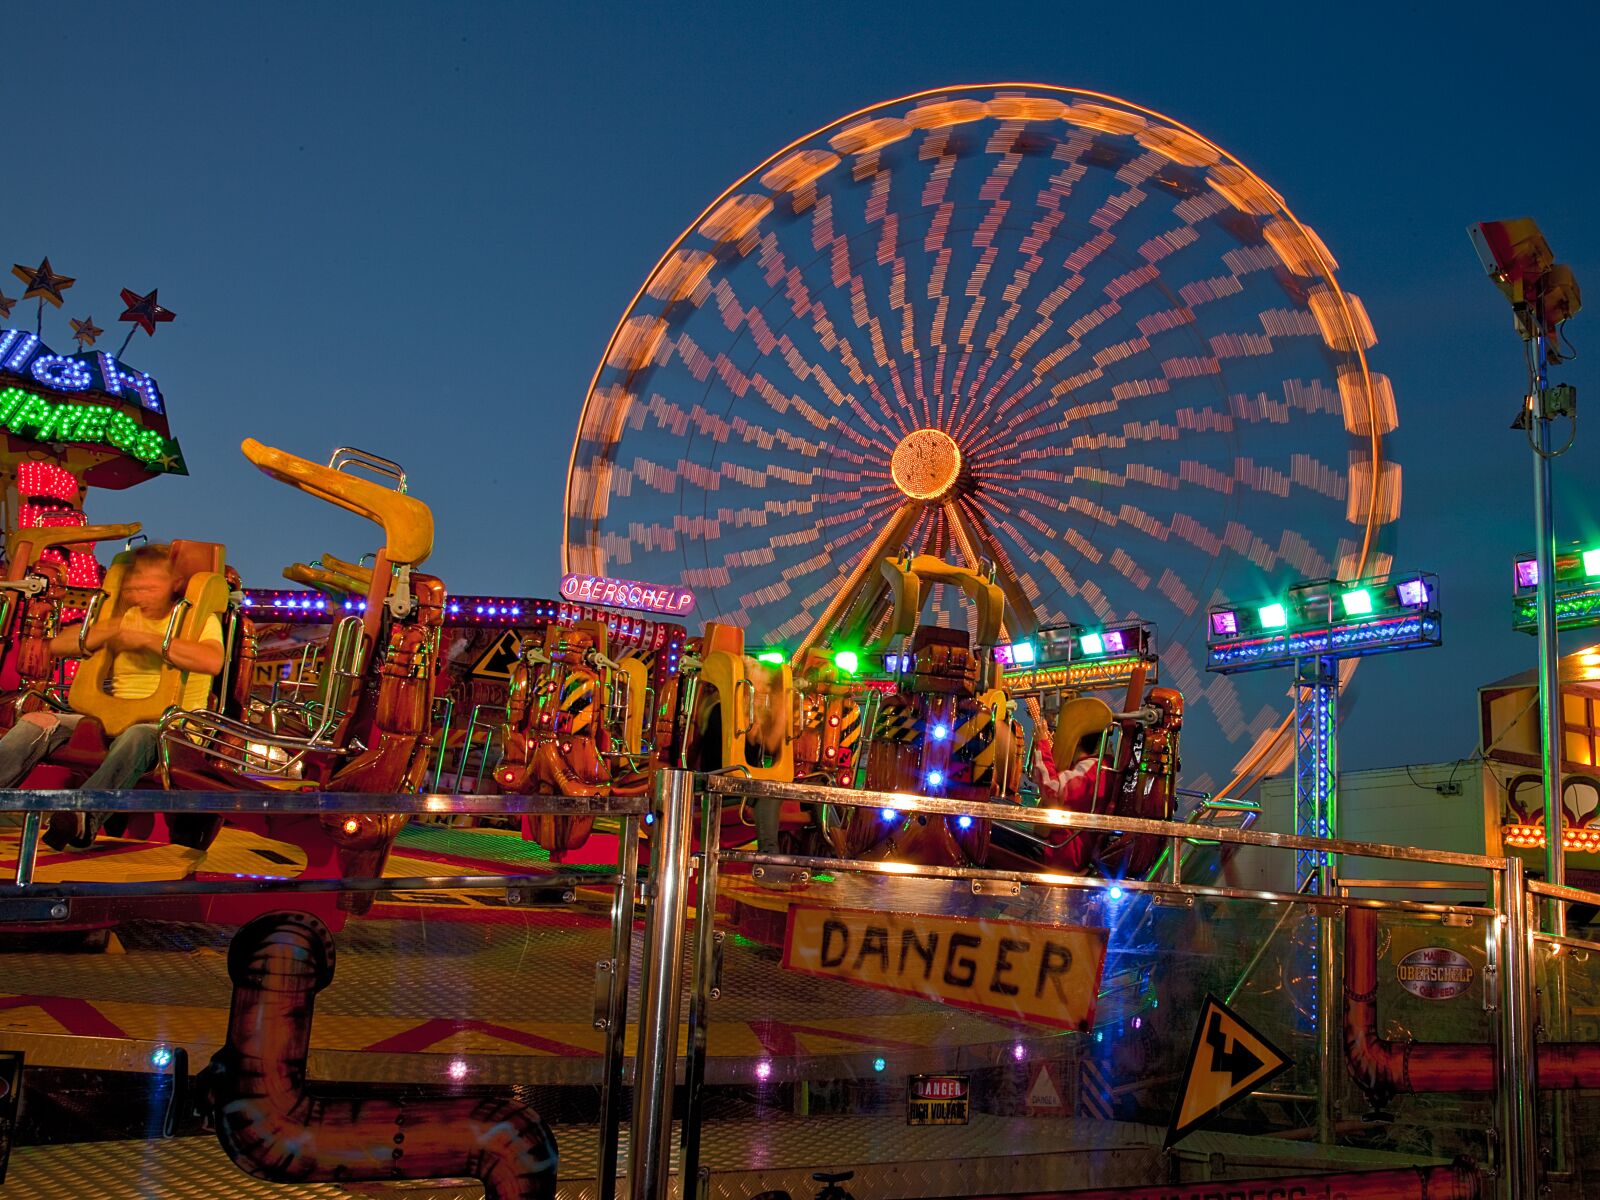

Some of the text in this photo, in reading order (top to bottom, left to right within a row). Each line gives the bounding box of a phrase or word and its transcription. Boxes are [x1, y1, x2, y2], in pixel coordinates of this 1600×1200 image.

[563, 577, 692, 610] OBERSCHELP
[820, 918, 1074, 1005] DANGER
[1399, 965, 1473, 982] OBERSCHELP
[917, 1081, 961, 1096] DANGER
[911, 1103, 929, 1119] HIGH
